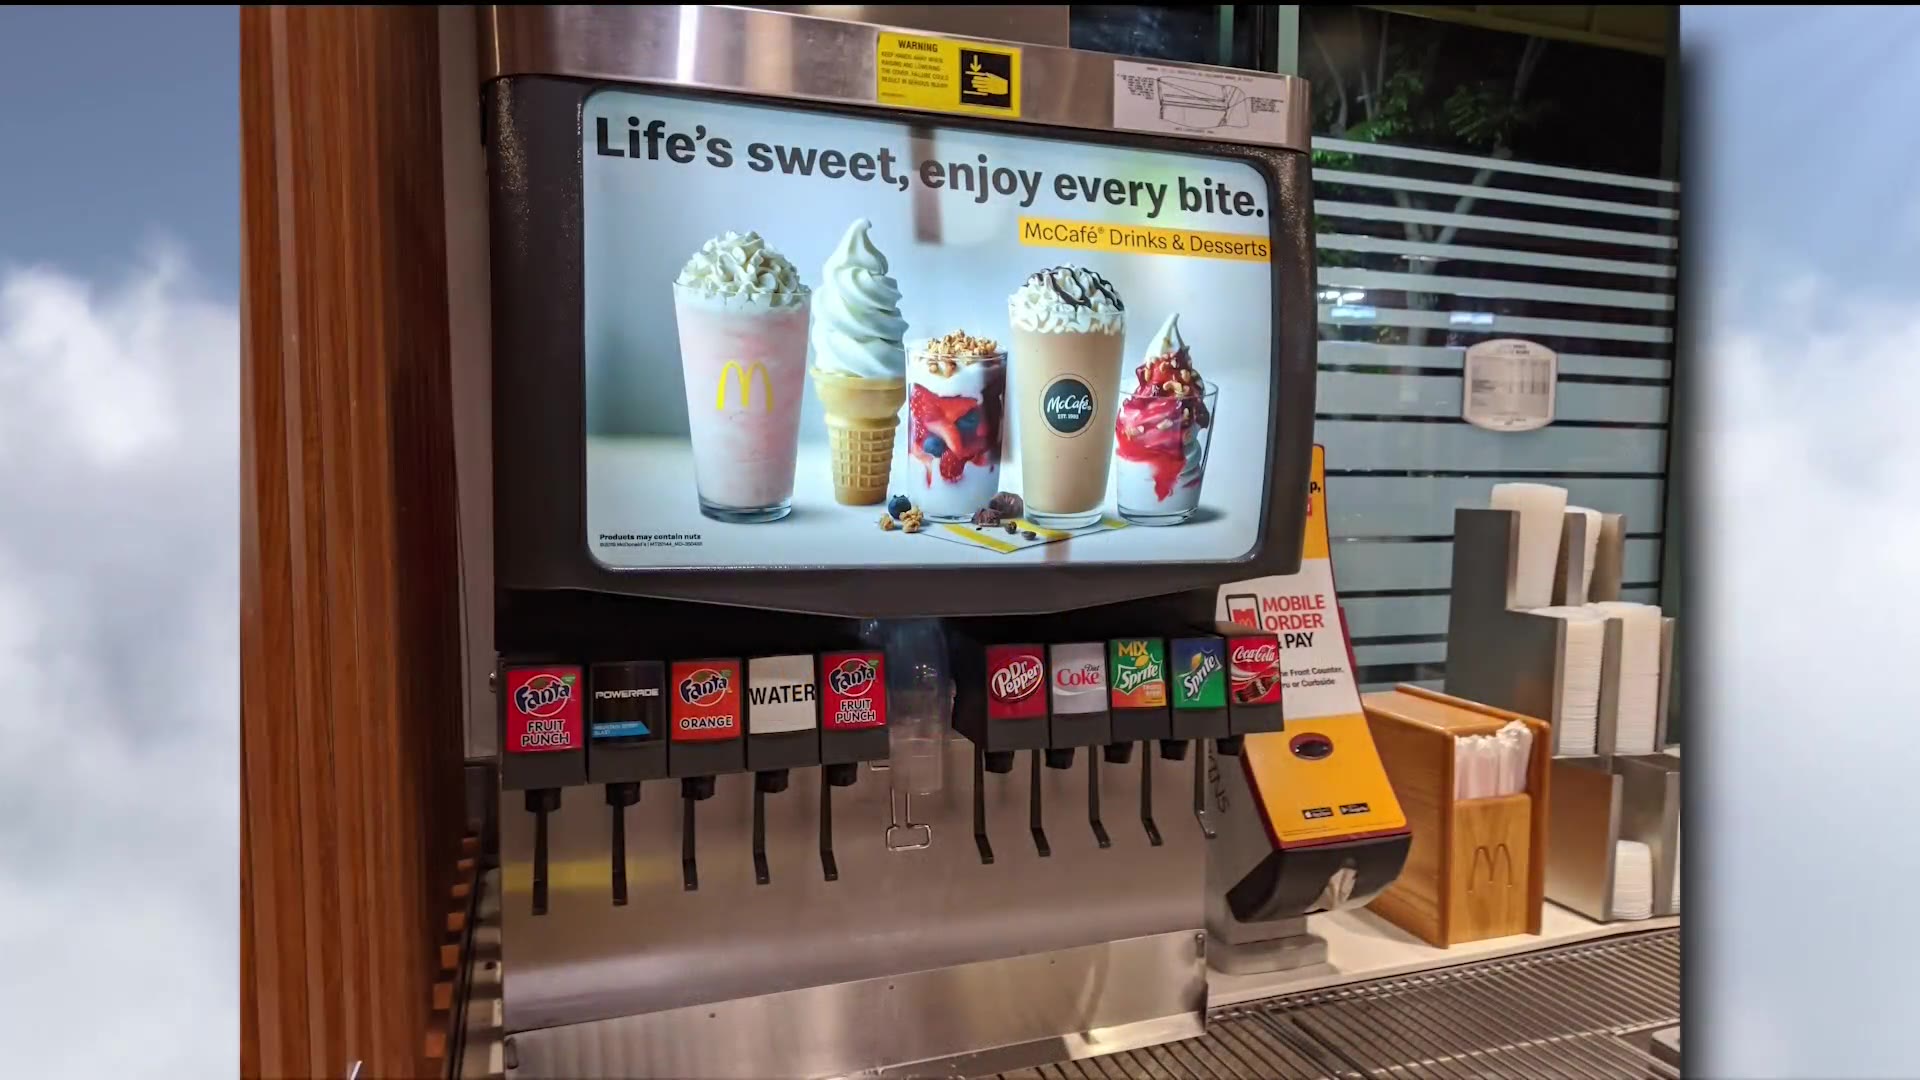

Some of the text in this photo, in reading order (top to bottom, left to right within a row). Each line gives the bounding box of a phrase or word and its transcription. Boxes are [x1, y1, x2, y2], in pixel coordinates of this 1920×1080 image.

[898, 40, 938, 52] WARNING
[596, 116, 1265, 218] Life's sweet, enjoy every bite.
[1110, 229, 1167, 250] Drinks
[1172, 236, 1185, 250] &
[1190, 237, 1267, 257] Desserts
[600, 533, 635, 541] Products
[636, 534, 652, 542] may
[1263, 594, 1326, 612] MOBILE
[1265, 613, 1324, 630] ORDER
[1118, 640, 1148, 656] MIX
[1284, 632, 1313, 648] PAY
[1009, 661, 1028, 681] Dr
[1084, 663, 1100, 672] Diet
[1290, 669, 1310, 677] Front
[829, 665, 876, 695] Fanta
[998, 664, 1039, 698] Pepper
[1057, 669, 1099, 686] Coke
[1120, 663, 1158, 690] Sprite
[1183, 654, 1216, 698] Sprite
[1301, 679, 1336, 687] Curbside
[514, 680, 571, 714] Fanta
[595, 688, 659, 700] POWERADE
[679, 674, 728, 704] Fanta
[750, 684, 816, 705] WATER
[841, 698, 872, 711] FRUIT
[680, 715, 733, 730] ORANGE
[835, 711, 876, 724] PUNCH
[527, 719, 566, 734] FRUIT
[521, 732, 570, 747] PUNCH
